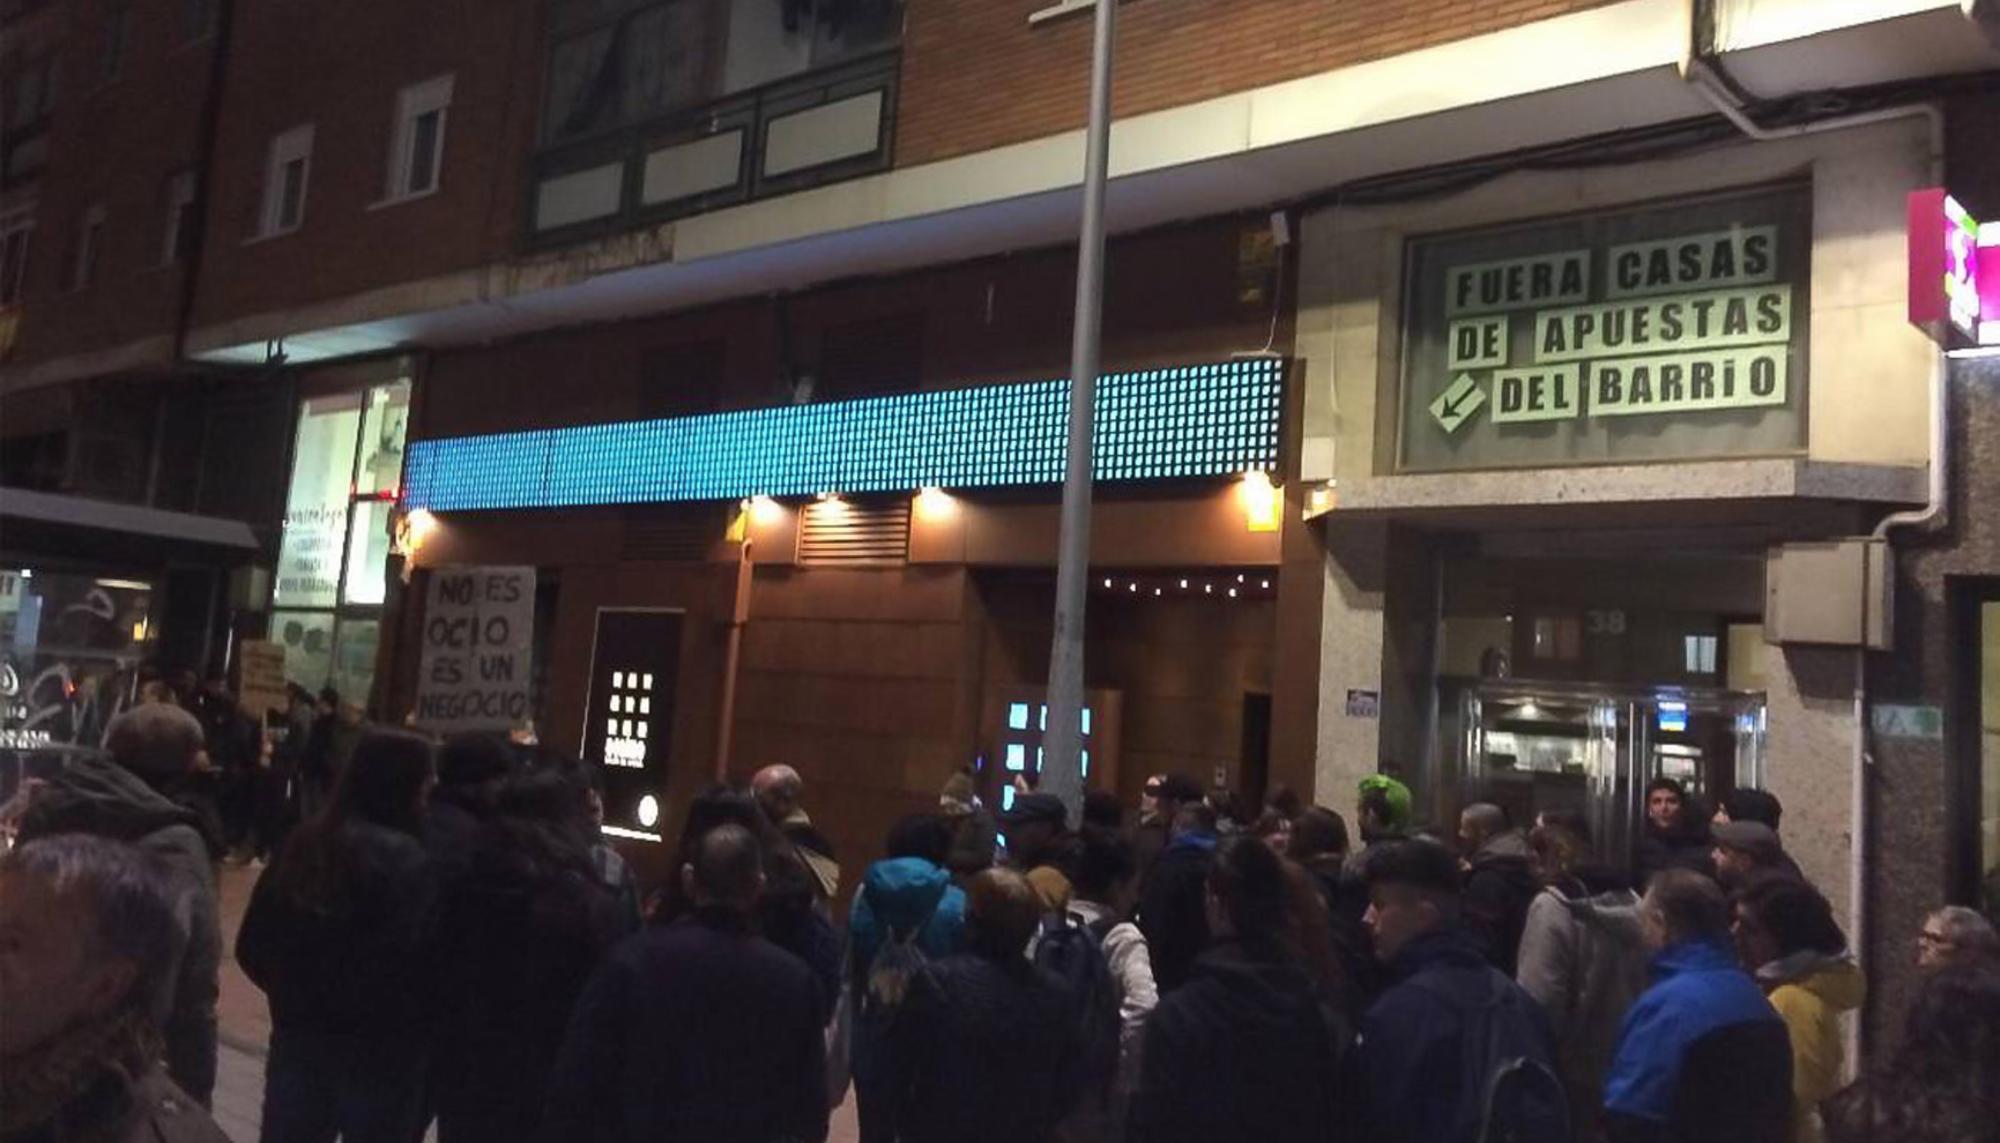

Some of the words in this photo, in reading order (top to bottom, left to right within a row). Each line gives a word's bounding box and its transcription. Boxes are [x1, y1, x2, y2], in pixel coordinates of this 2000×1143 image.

[1458, 258, 1583, 307] FUERA
[1617, 234, 1769, 291] CASAS
[1456, 323, 1499, 361] DE
[1543, 293, 1782, 353] APUESTAS
[1500, 373, 1569, 413] DEL
[439, 576, 474, 605] NO
[486, 575, 521, 602] ES
[428, 613, 509, 646] OCIO
[1587, 610, 1626, 633] 38
[431, 657, 463, 684] ES
[480, 654, 514, 681] UN
[419, 690, 526, 720] NEGOCIO
